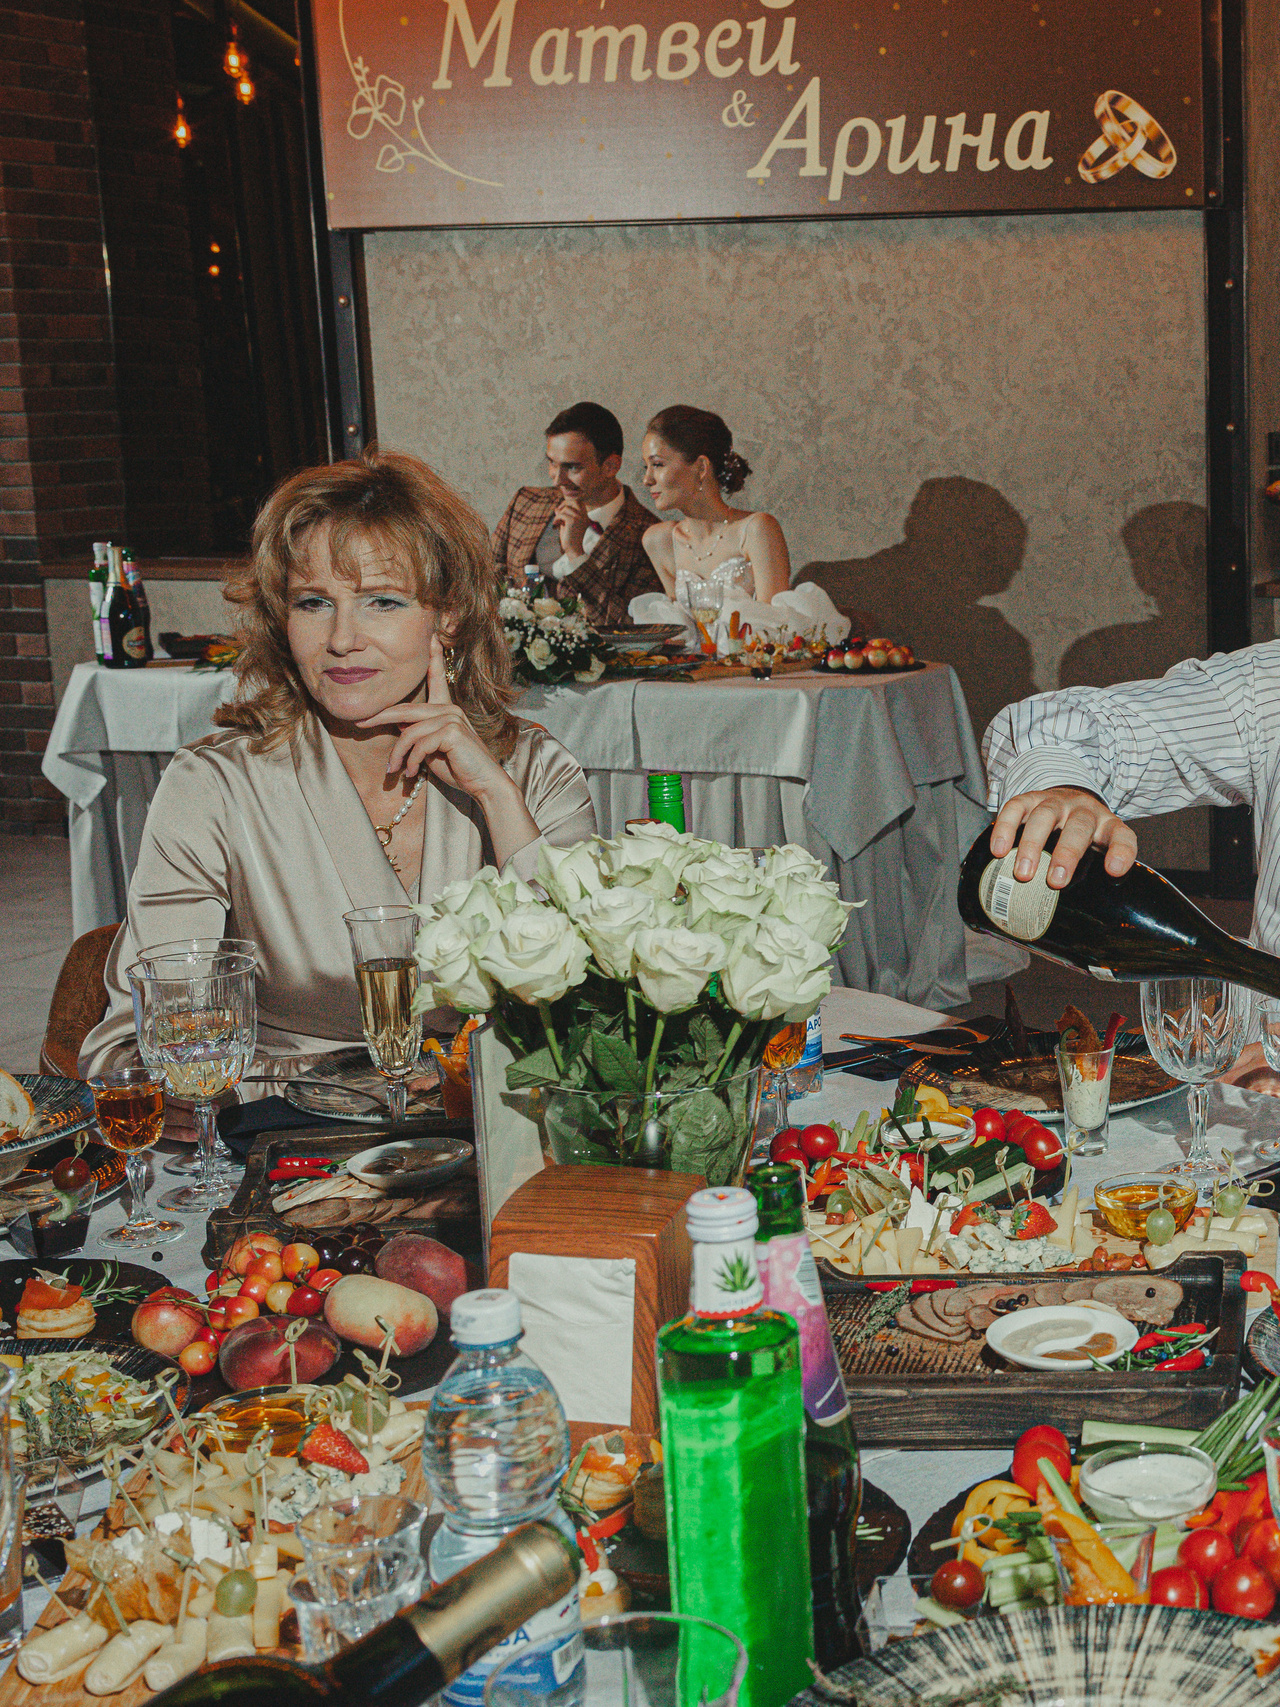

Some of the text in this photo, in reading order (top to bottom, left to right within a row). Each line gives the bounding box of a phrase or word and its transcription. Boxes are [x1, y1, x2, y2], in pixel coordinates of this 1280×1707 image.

[432, 0, 801, 89] Матвей
[722, 90, 756, 128] &
[747, 76, 1054, 201] Арина
